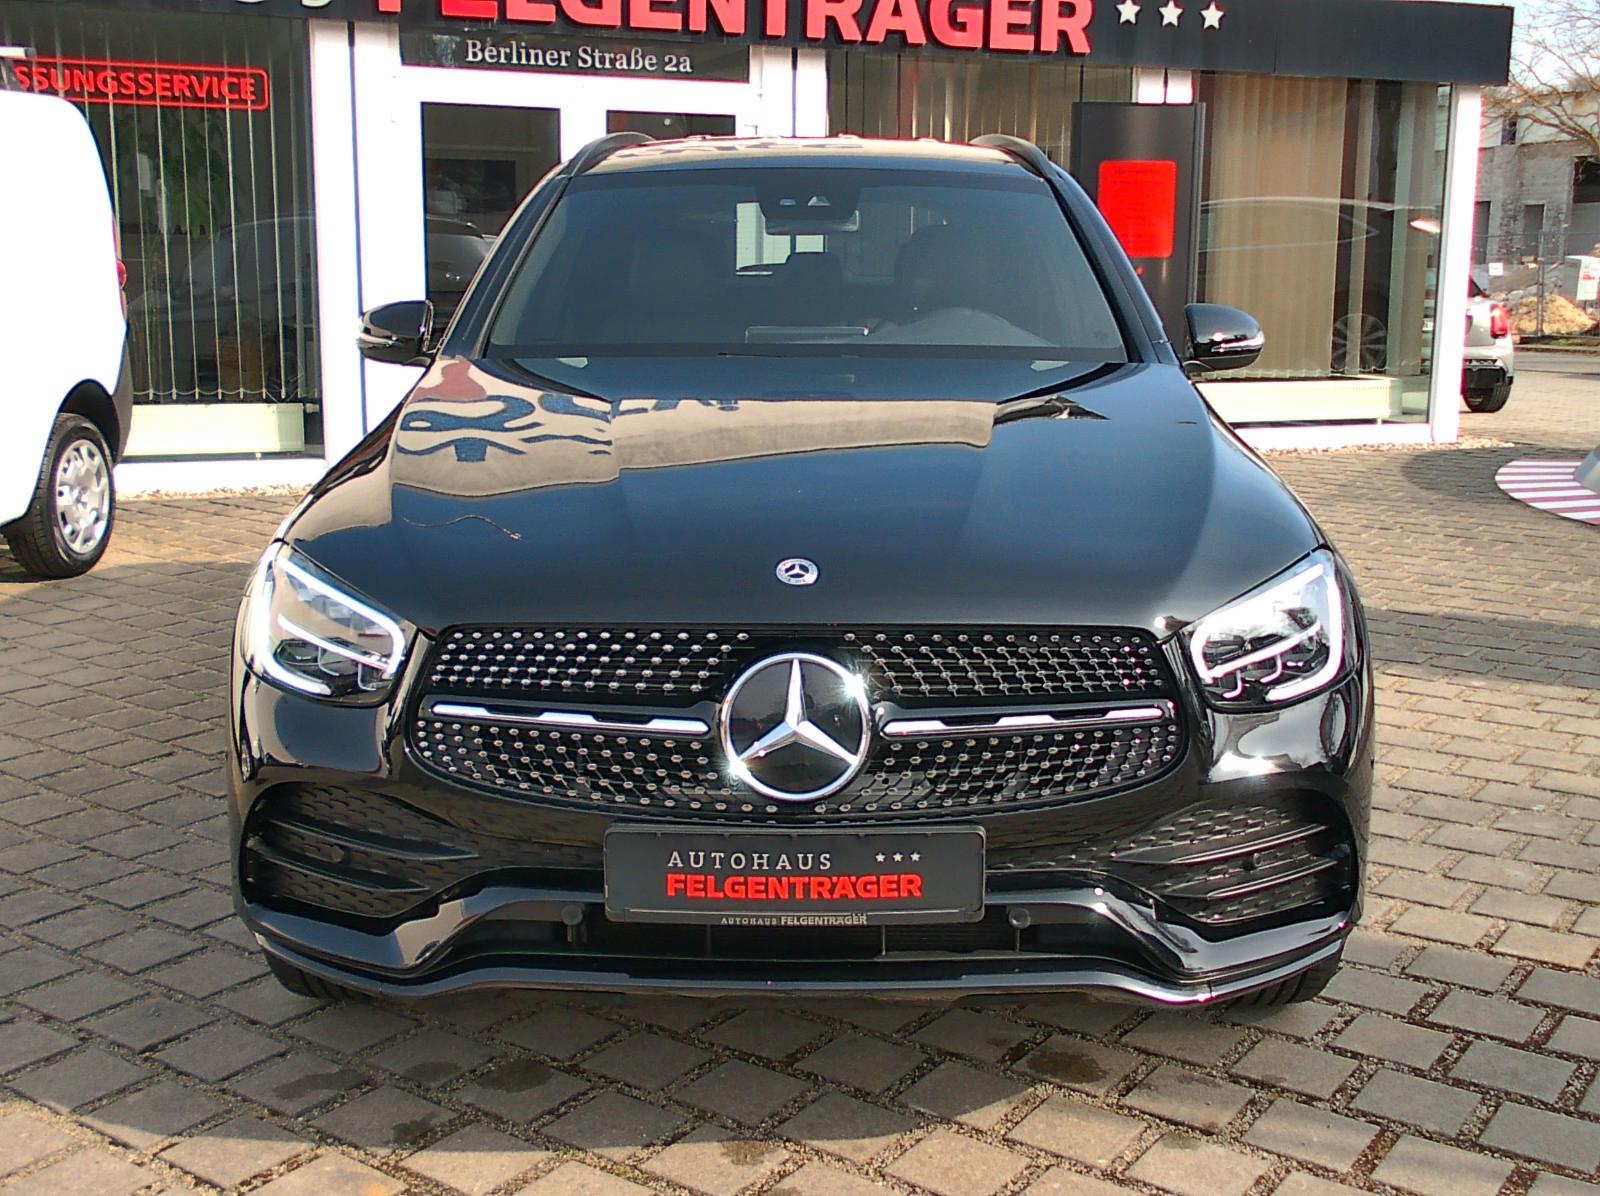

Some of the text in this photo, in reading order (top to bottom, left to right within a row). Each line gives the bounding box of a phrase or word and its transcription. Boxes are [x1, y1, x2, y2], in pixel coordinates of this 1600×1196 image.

[379, 0, 1092, 54] NTRGER
[465, 39, 693, 73] Berliner Straße 2a
[667, 851, 831, 870] AUTOHAUS
[667, 873, 922, 899] FELGENTRÄGER
